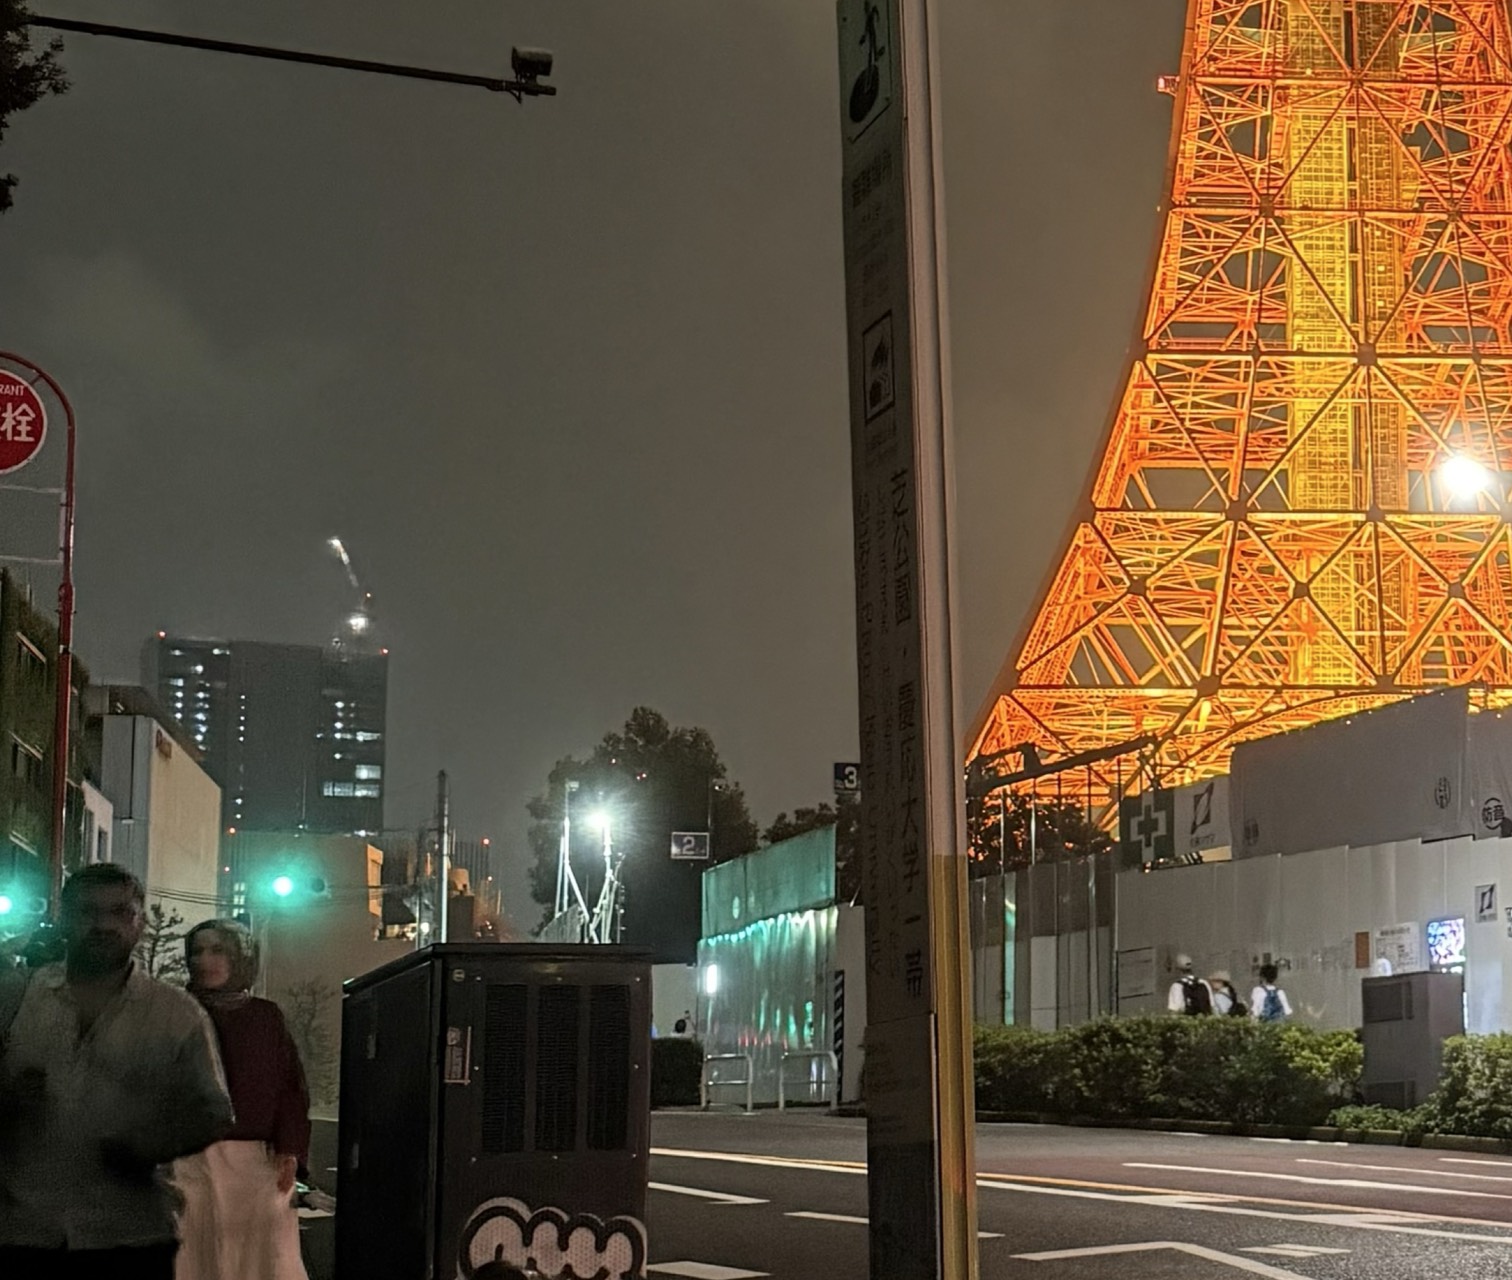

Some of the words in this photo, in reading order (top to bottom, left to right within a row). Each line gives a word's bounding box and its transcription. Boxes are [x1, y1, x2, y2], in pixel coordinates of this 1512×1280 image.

[0, 403, 36, 441] 栓
[845, 766, 857, 788] 3
[683, 836, 695, 855] 2
